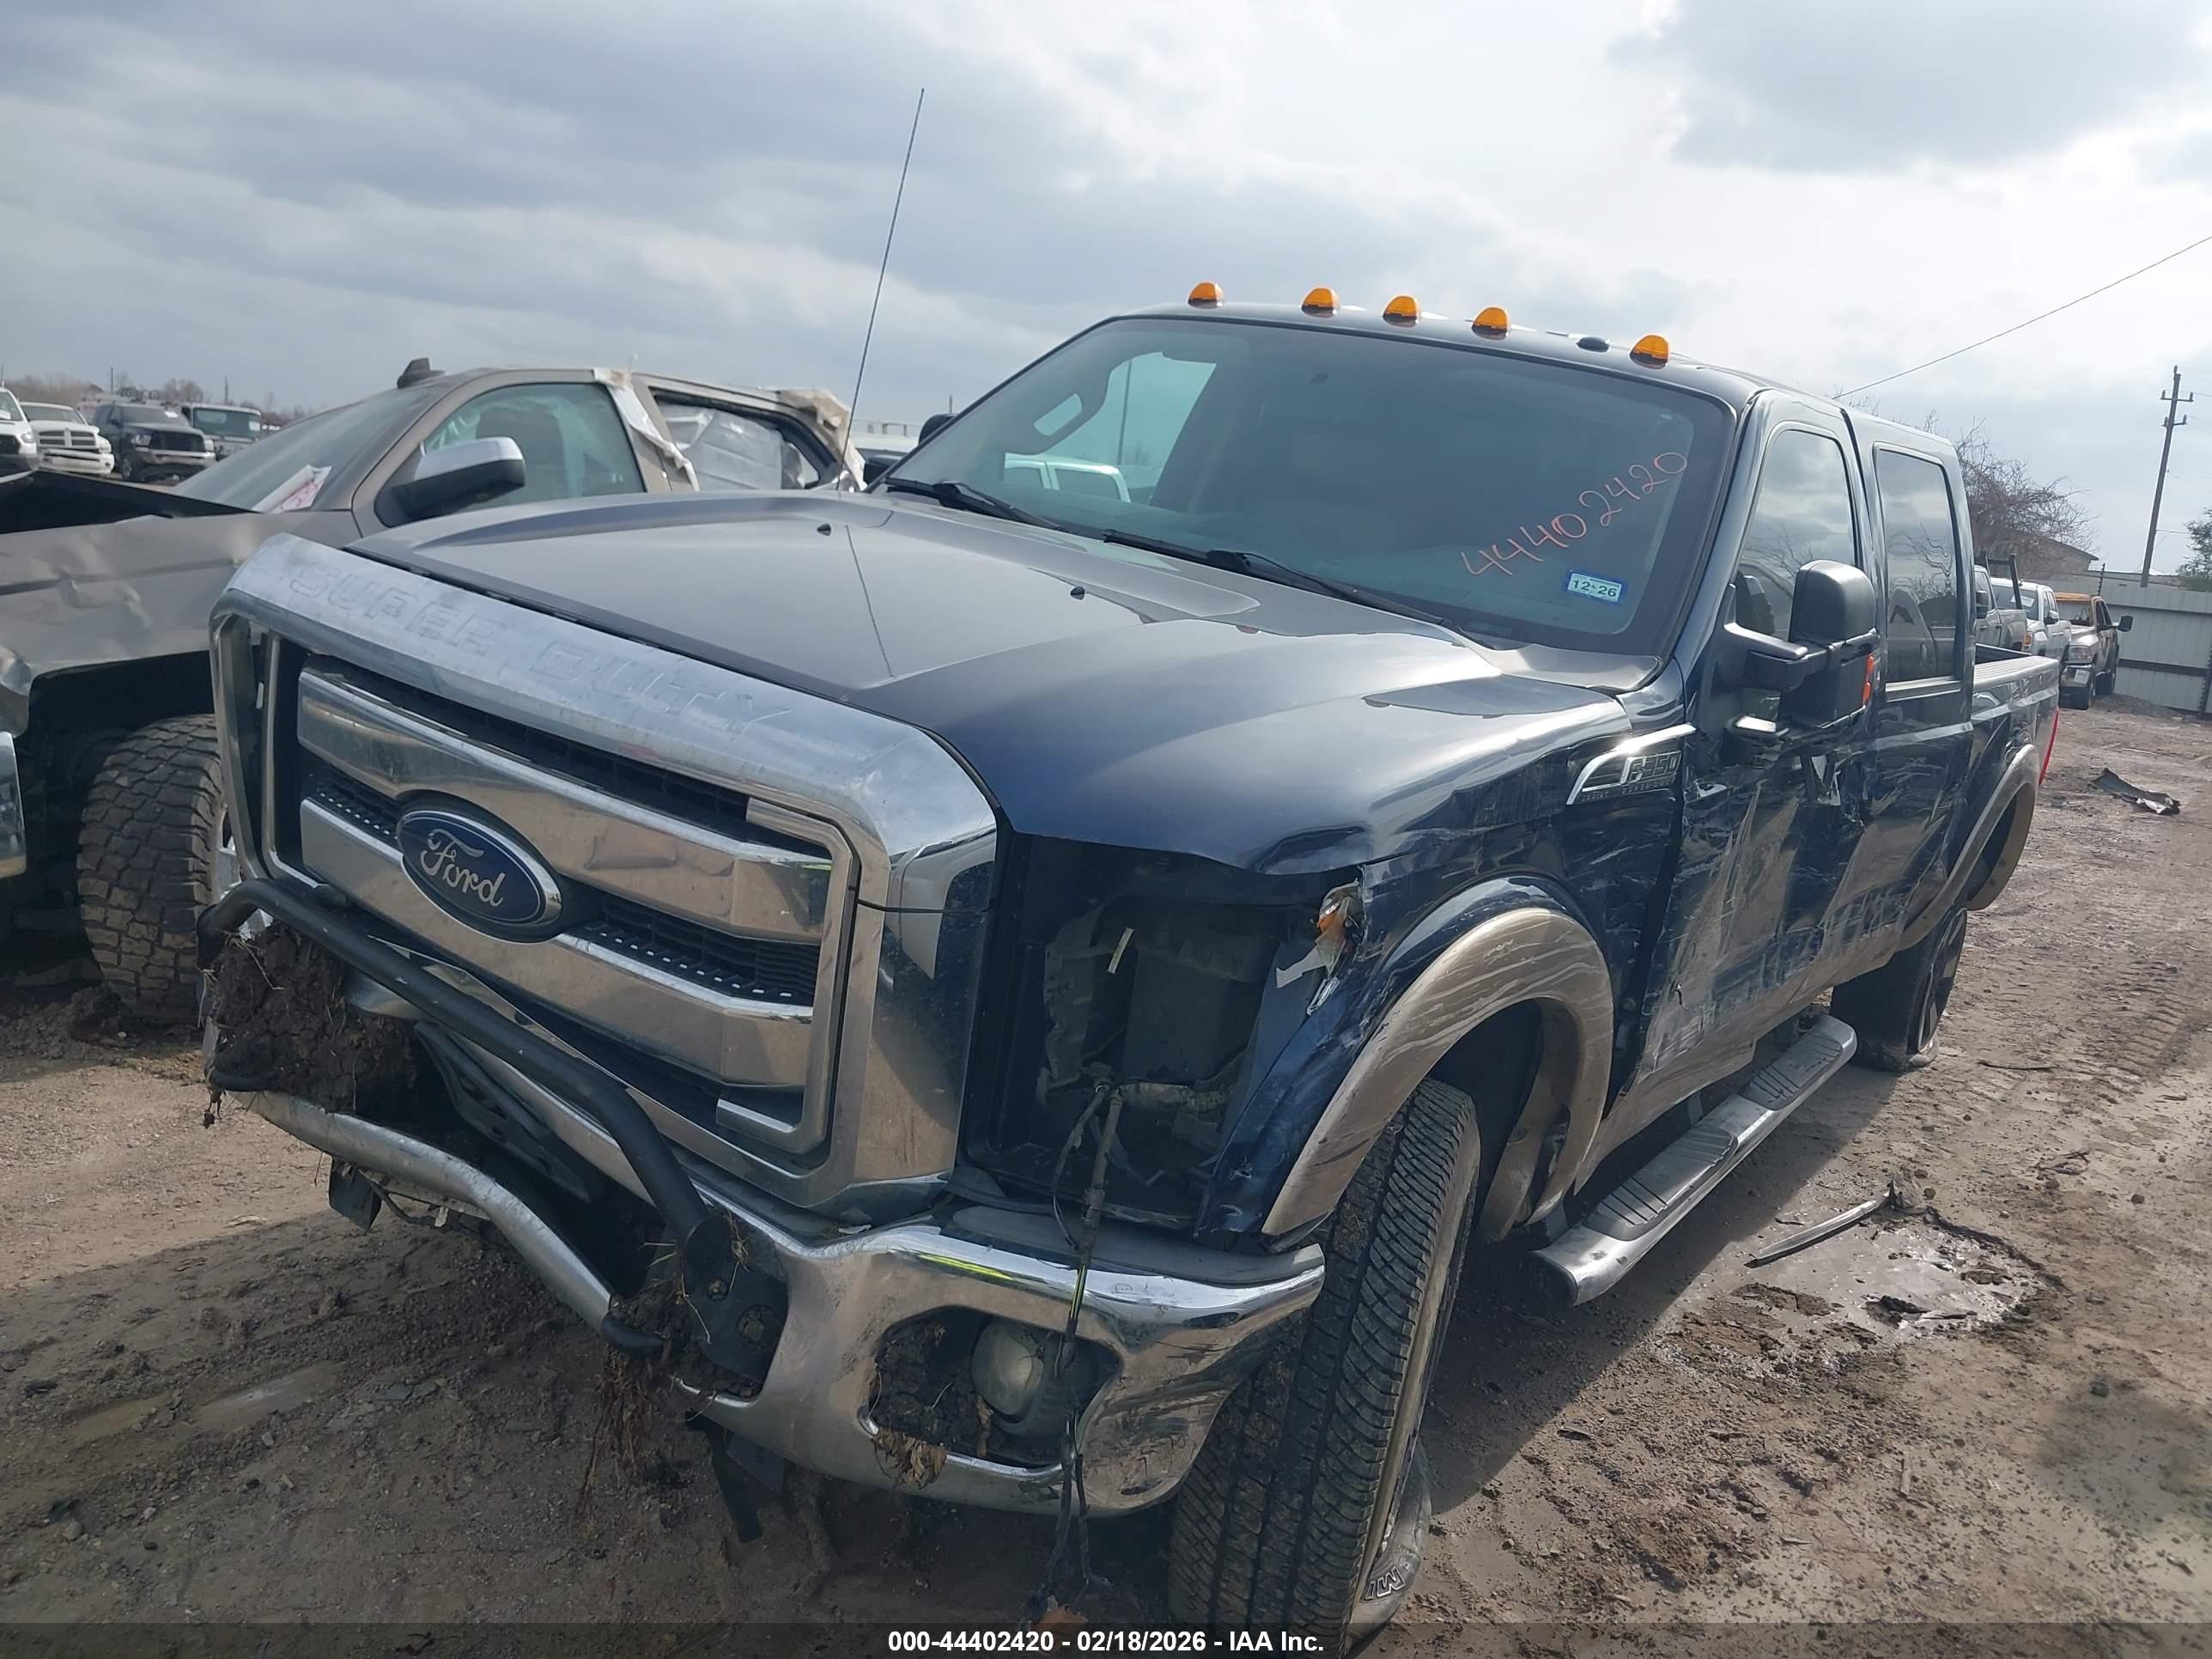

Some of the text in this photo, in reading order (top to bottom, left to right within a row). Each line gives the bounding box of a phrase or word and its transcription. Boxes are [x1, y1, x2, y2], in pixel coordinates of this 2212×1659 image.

[1461, 452, 1688, 576] 44402420
[289, 562, 793, 735] SUPER DUTY
[420, 828, 507, 907] Ford
